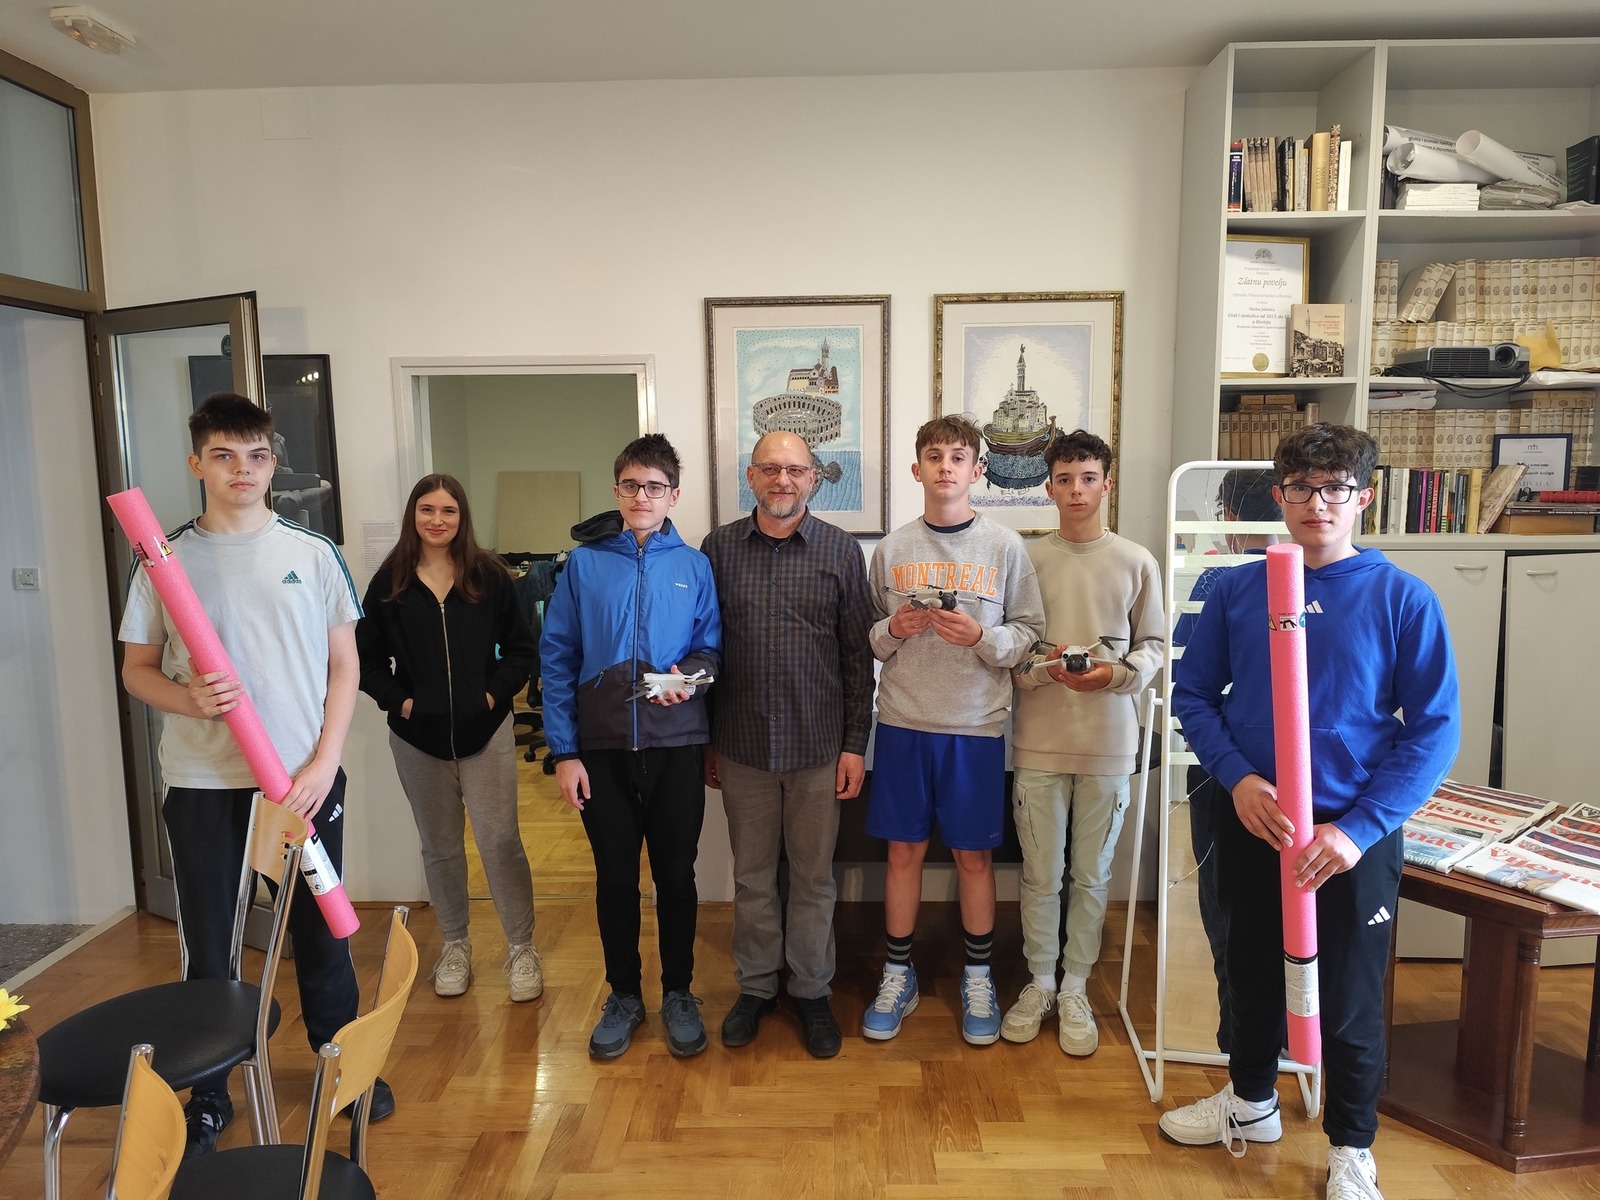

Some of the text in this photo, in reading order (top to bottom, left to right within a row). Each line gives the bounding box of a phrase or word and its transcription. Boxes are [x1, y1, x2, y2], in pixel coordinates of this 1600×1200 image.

[1237, 277, 1287, 289] Zlatnu povelju
[891, 561, 998, 597] MONTREAL
